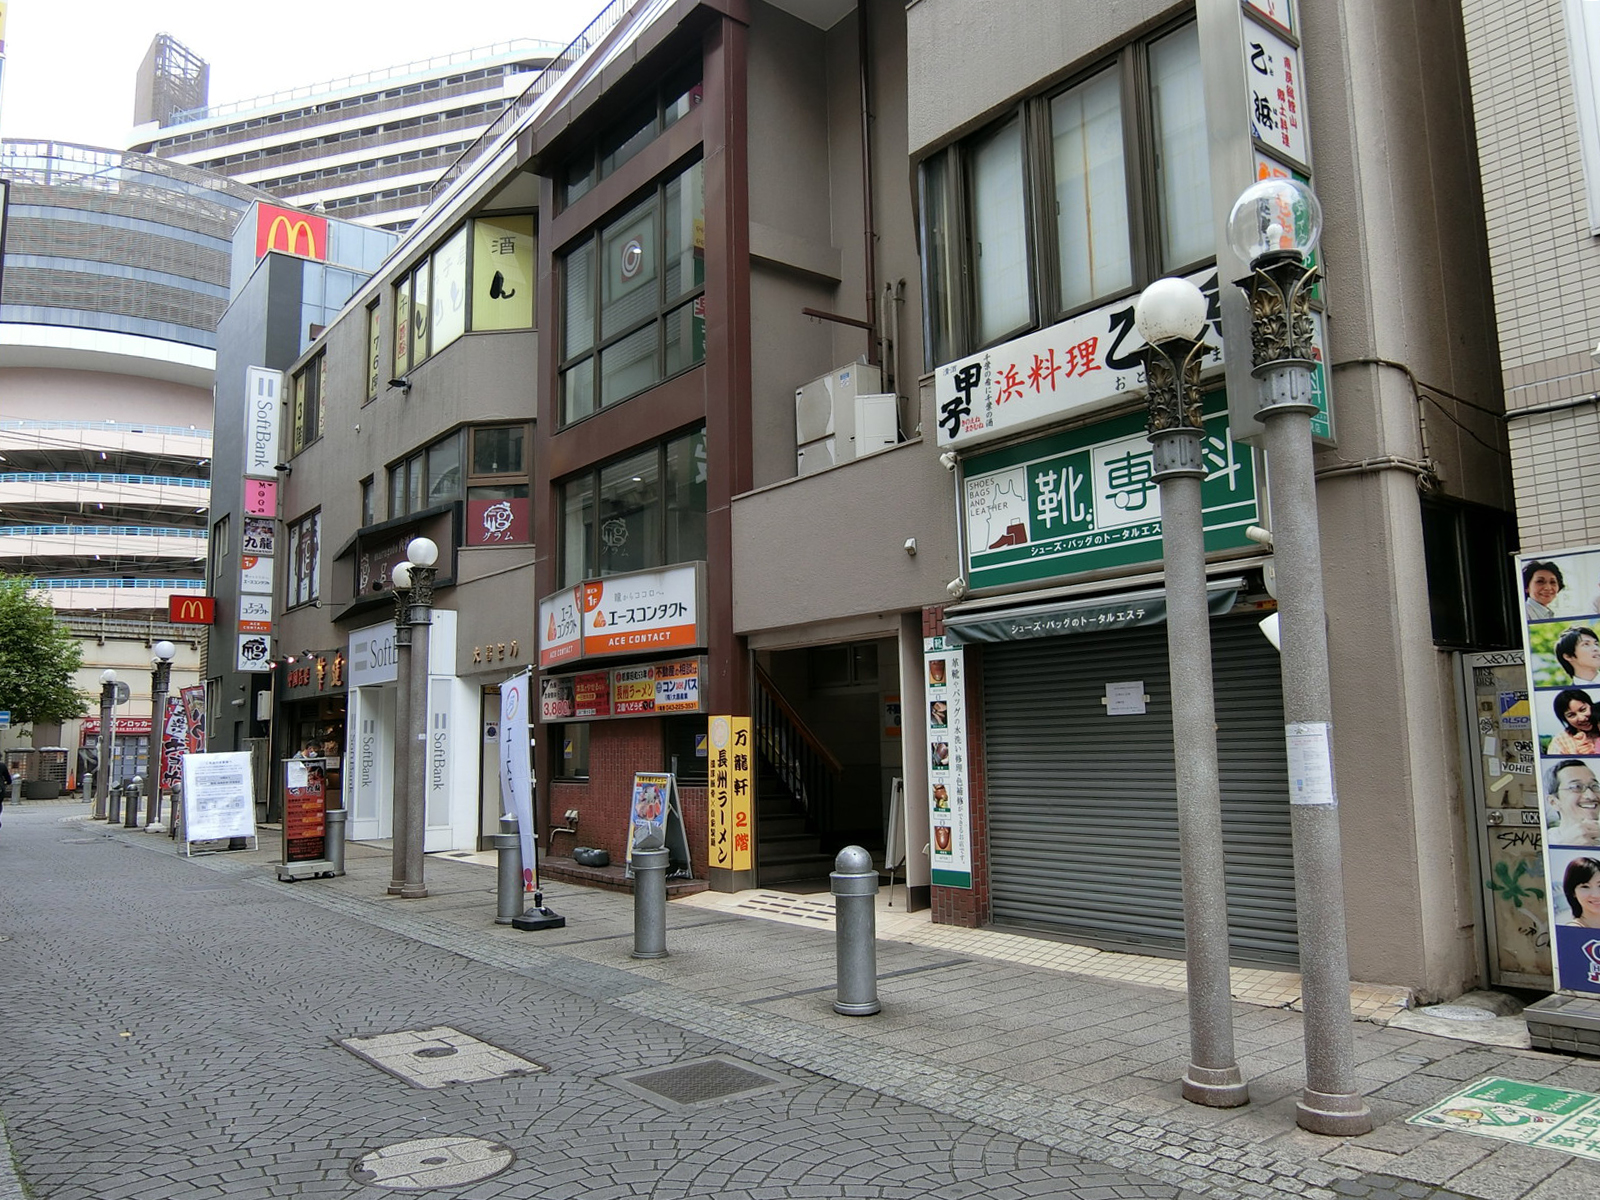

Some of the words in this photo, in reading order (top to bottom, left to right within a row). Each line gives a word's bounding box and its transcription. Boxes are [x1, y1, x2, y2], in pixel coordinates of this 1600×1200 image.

[994, 335, 1102, 406] 浜料理
[938, 362, 982, 438] 甲子
[254, 400, 273, 468] SoftBank
[968, 477, 995, 490] SHOES
[968, 488, 991, 499] BAGS
[969, 498, 987, 508] AND
[970, 501, 1009, 517] LEATHER
[482, 532, 513, 542] グラム
[587, 595, 598, 606] 1F
[561, 604, 573, 622] エース
[607, 602, 688, 627] エースコンタクト
[608, 637, 626, 647] ACE
[629, 631, 671, 644] CONTACT
[617, 684, 654, 700] 長州ラーメン
[362, 736, 374, 788] SoftBank
[433, 731, 446, 791] SoftBank
[733, 729, 749, 796] 万龍軒
[716, 749, 728, 864] 長州ラーメン
[734, 811, 749, 852] 2階
